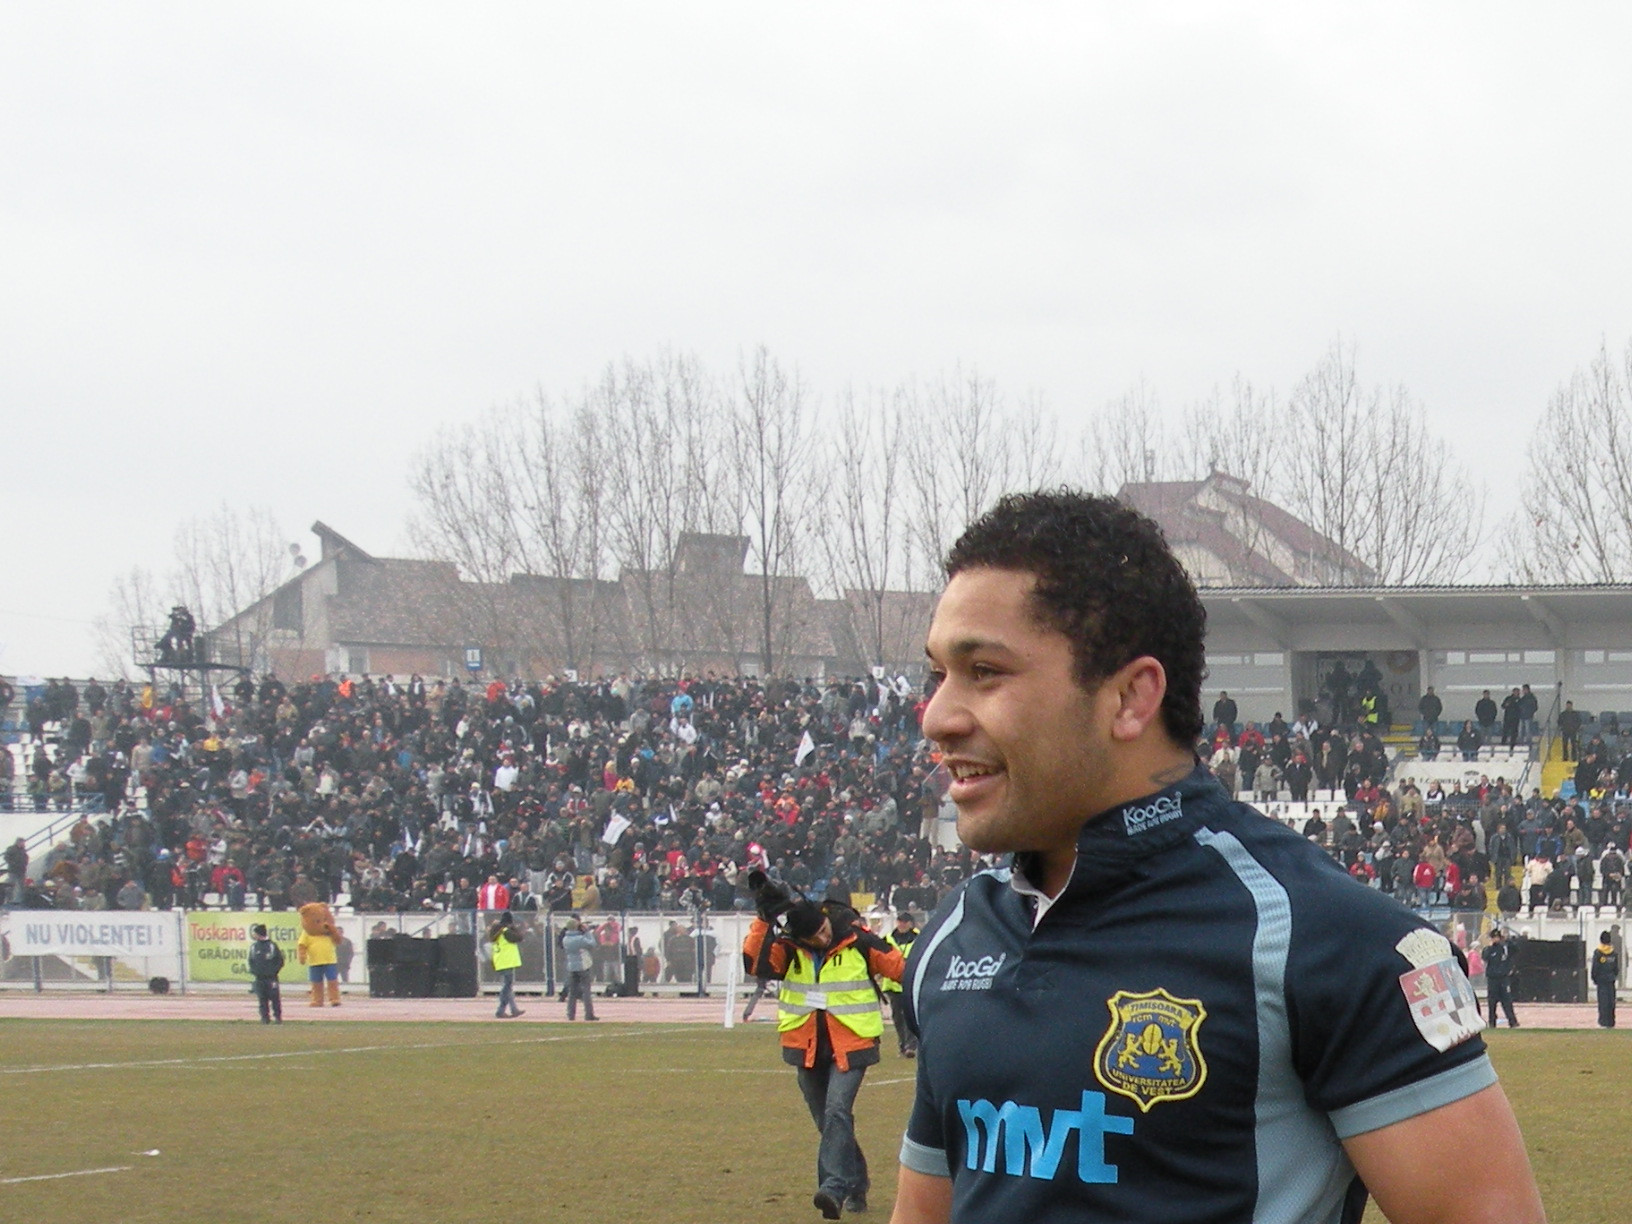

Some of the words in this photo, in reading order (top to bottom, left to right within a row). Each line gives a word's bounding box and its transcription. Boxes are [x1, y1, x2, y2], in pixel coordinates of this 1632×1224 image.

[26, 924, 50, 944] NU
[190, 922, 246, 941] Toskana
[945, 955, 1003, 979] KooGa
[1112, 1068, 1186, 1087] UNIVERSITATEA
[1122, 1083, 1138, 1093] DE
[1141, 1086, 1173, 1096] VEST
[957, 1089, 1135, 1184] mvt
